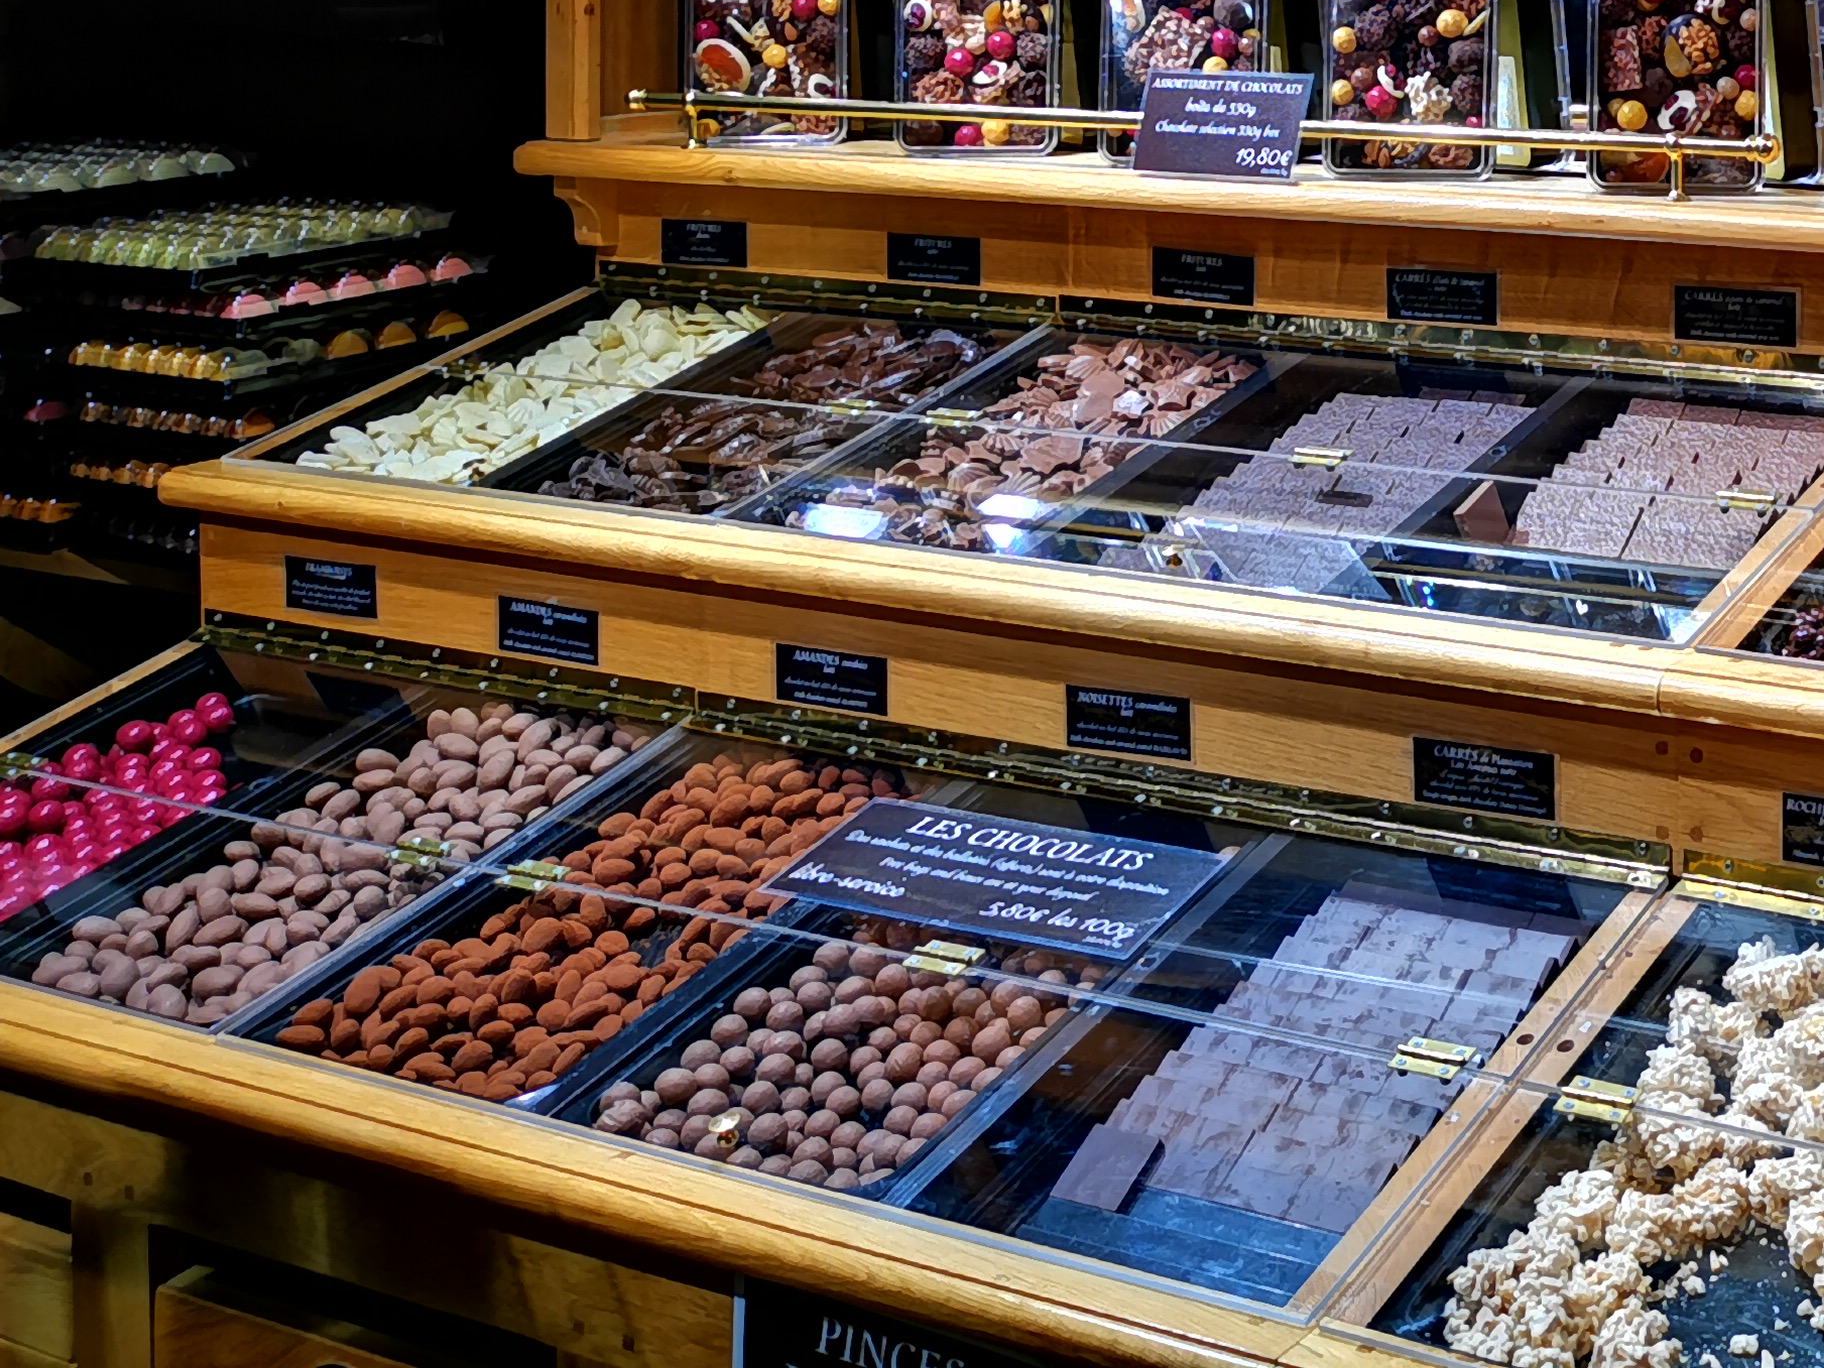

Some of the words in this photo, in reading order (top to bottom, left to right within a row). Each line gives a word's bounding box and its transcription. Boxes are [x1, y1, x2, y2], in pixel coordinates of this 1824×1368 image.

[1151, 77, 1224, 92] ASSORTIMENT
[1225, 80, 1240, 92] DE
[1241, 80, 1304, 95] CHOCOLATS
[1236, 147, 1293, 167] 19,80€
[905, 816, 972, 840] LES
[968, 828, 1154, 870] CHOCOLATS
[788, 862, 905, 898] libre-service
[1047, 908, 1078, 928] les
[1079, 917, 1135, 942] 100g
